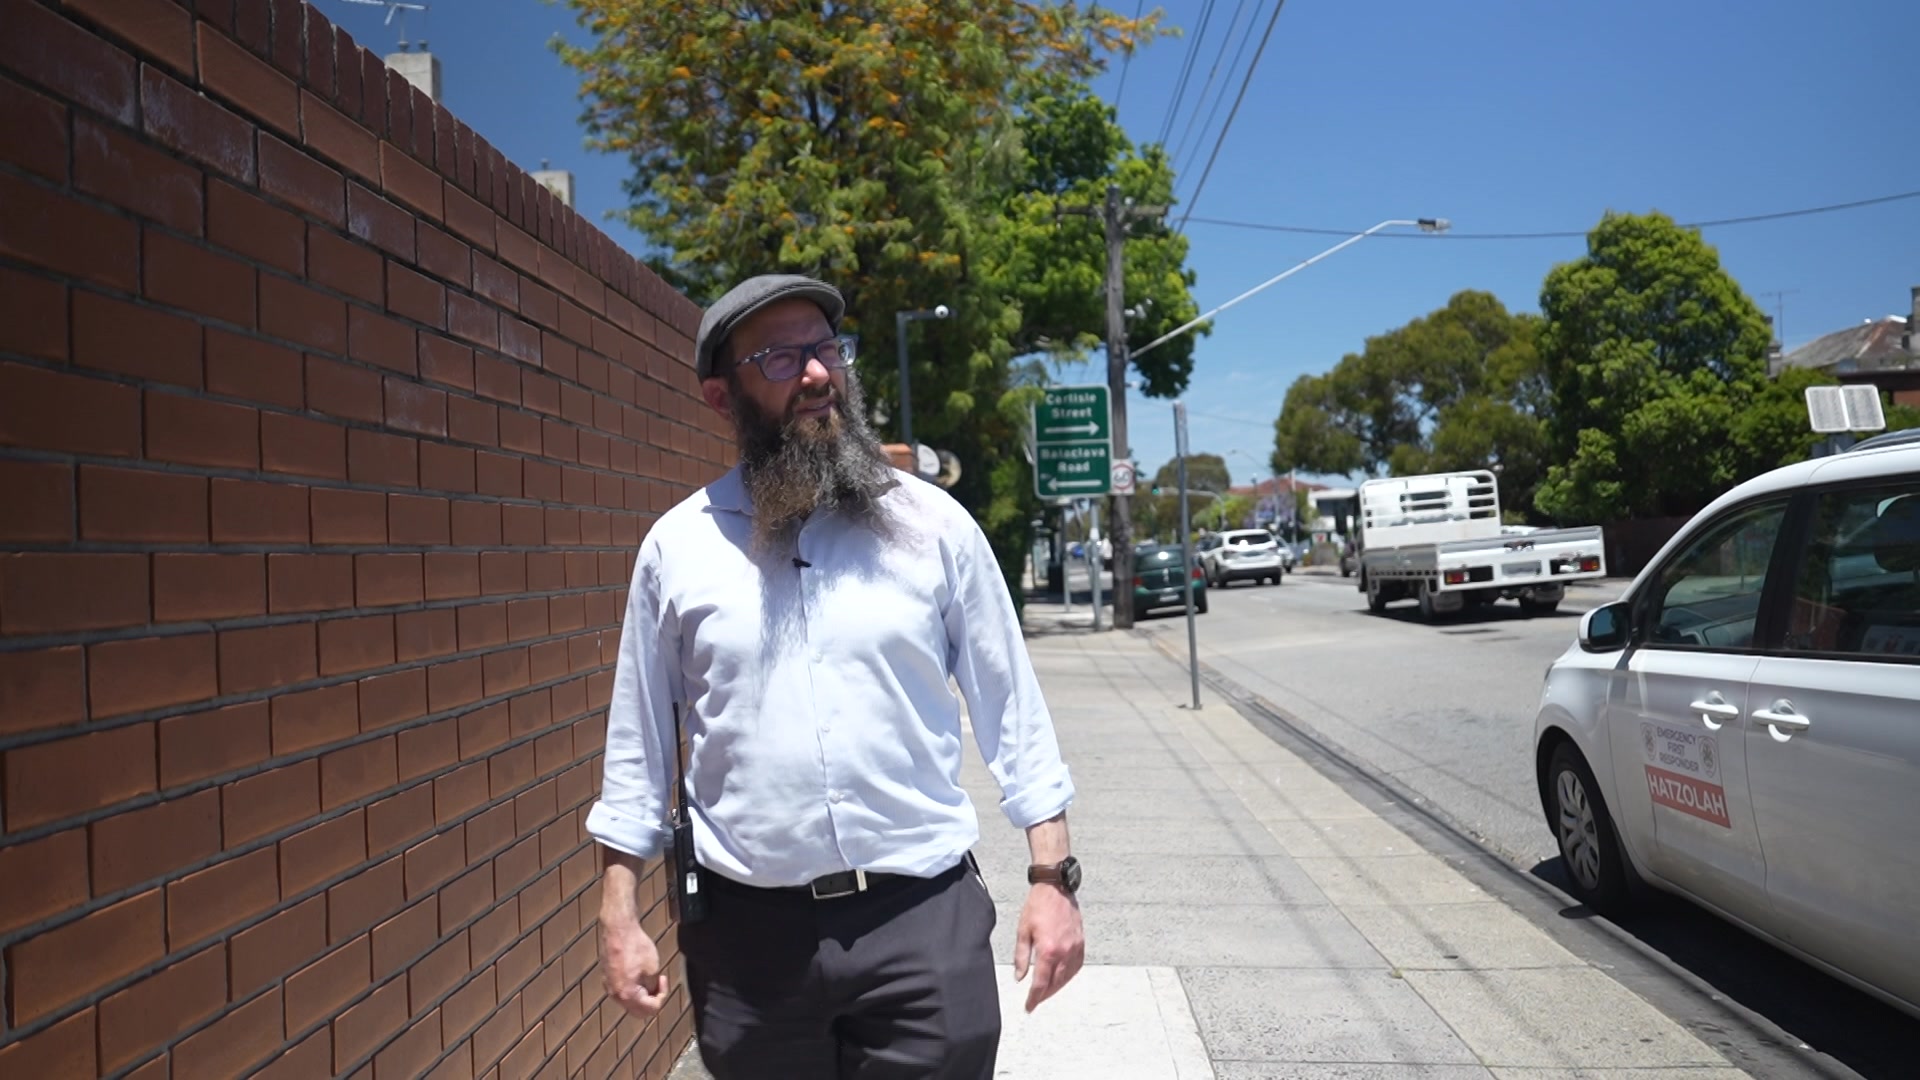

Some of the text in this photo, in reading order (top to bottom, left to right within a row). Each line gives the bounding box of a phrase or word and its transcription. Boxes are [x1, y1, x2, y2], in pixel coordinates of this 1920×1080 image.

[1046, 392, 1097, 405] Carlisle
[1051, 407, 1092, 418] Street
[1041, 447, 1106, 459] Balaclava
[1057, 461, 1091, 473] Road
[1657, 726, 1697, 745] EMERGENCY
[1667, 741, 1685, 757] FIRST
[1659, 752, 1699, 772] RESPONDER
[1647, 772, 1727, 818] HATZOLAH
